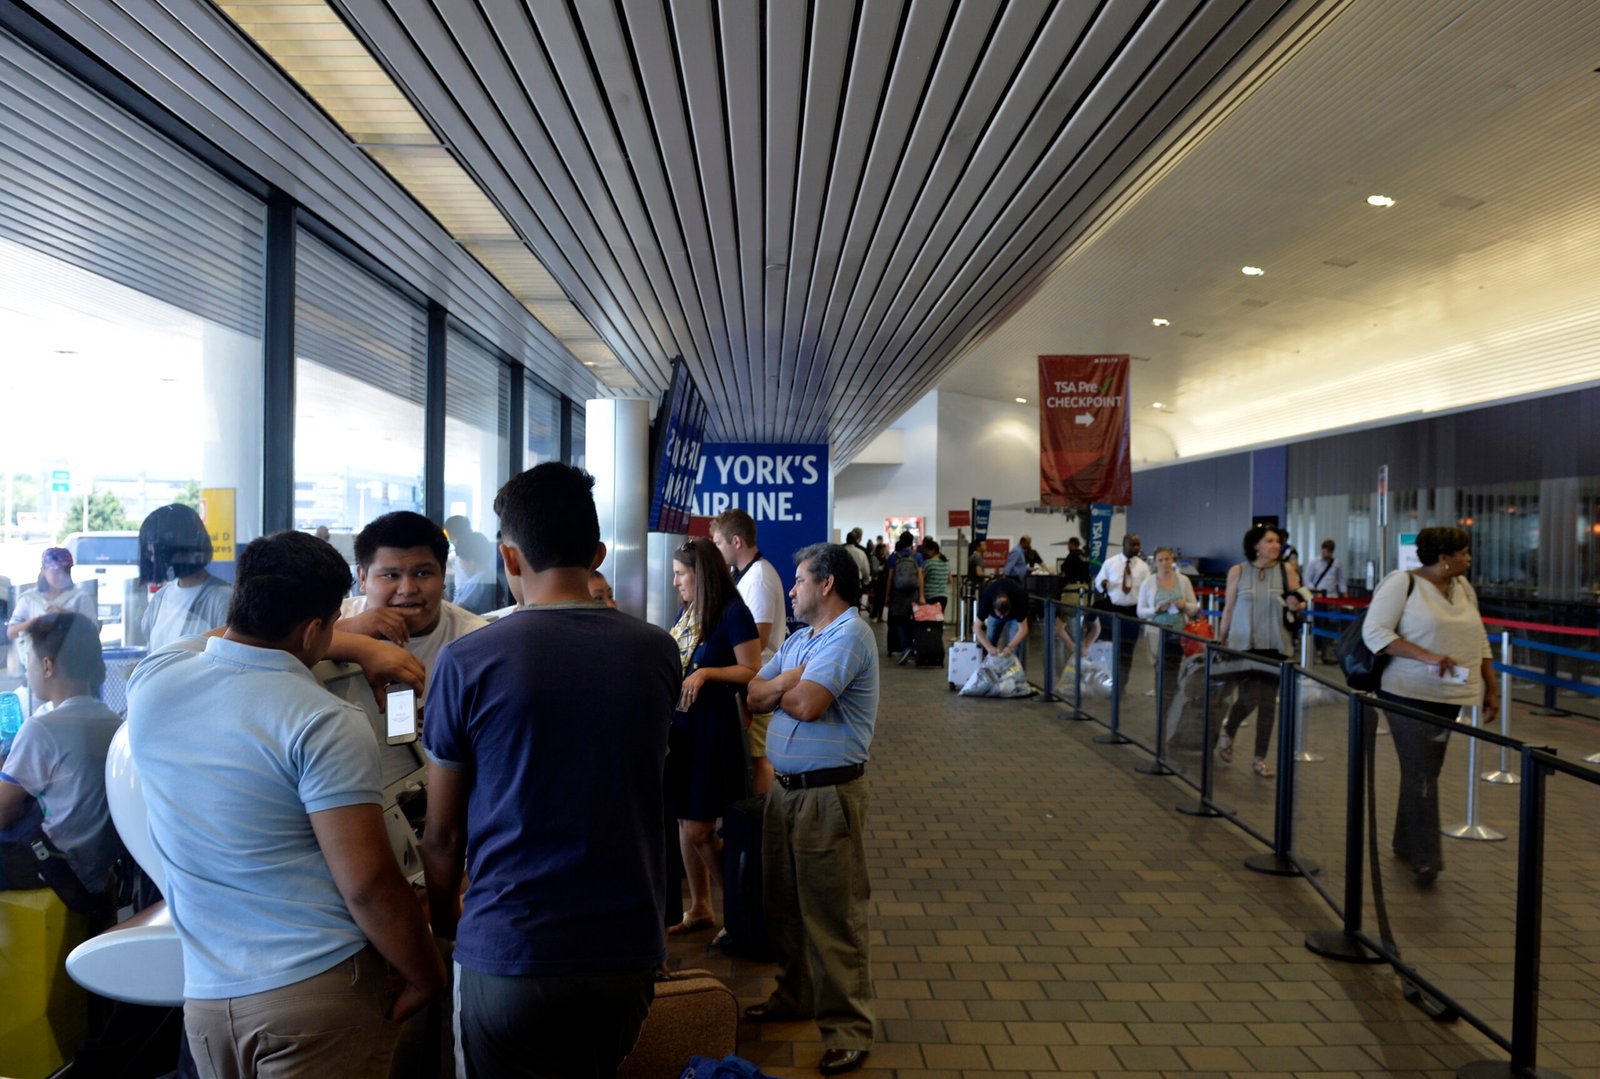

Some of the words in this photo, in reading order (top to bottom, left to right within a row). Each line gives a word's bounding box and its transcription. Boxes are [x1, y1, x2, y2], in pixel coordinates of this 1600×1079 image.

[1054, 381, 1077, 393] TSA
[1078, 381, 1098, 393] Pre
[1047, 396, 1122, 408] CHECKPOINT
[714, 455, 819, 485] YORK'S
[1092, 521, 1103, 540] TSA
